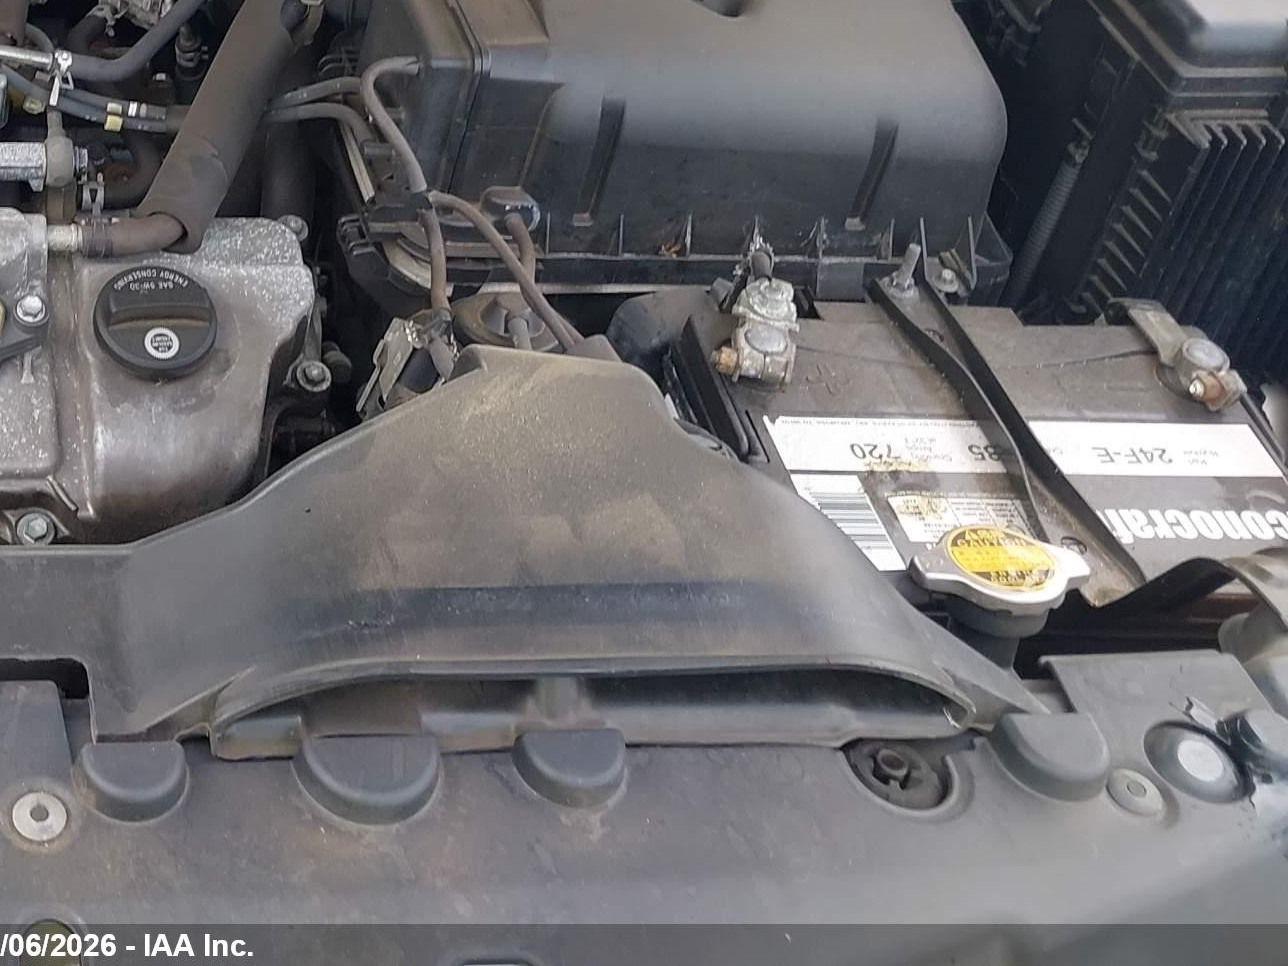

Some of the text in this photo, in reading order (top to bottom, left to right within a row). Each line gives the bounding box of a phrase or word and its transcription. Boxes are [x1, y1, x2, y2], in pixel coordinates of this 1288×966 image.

[113, 268, 189, 291] ENERGY CONSERVING
[129, 281, 174, 291] SAE 5W-30
[850, 442, 901, 460] 720
[1092, 446, 1173, 464] 24F-E
